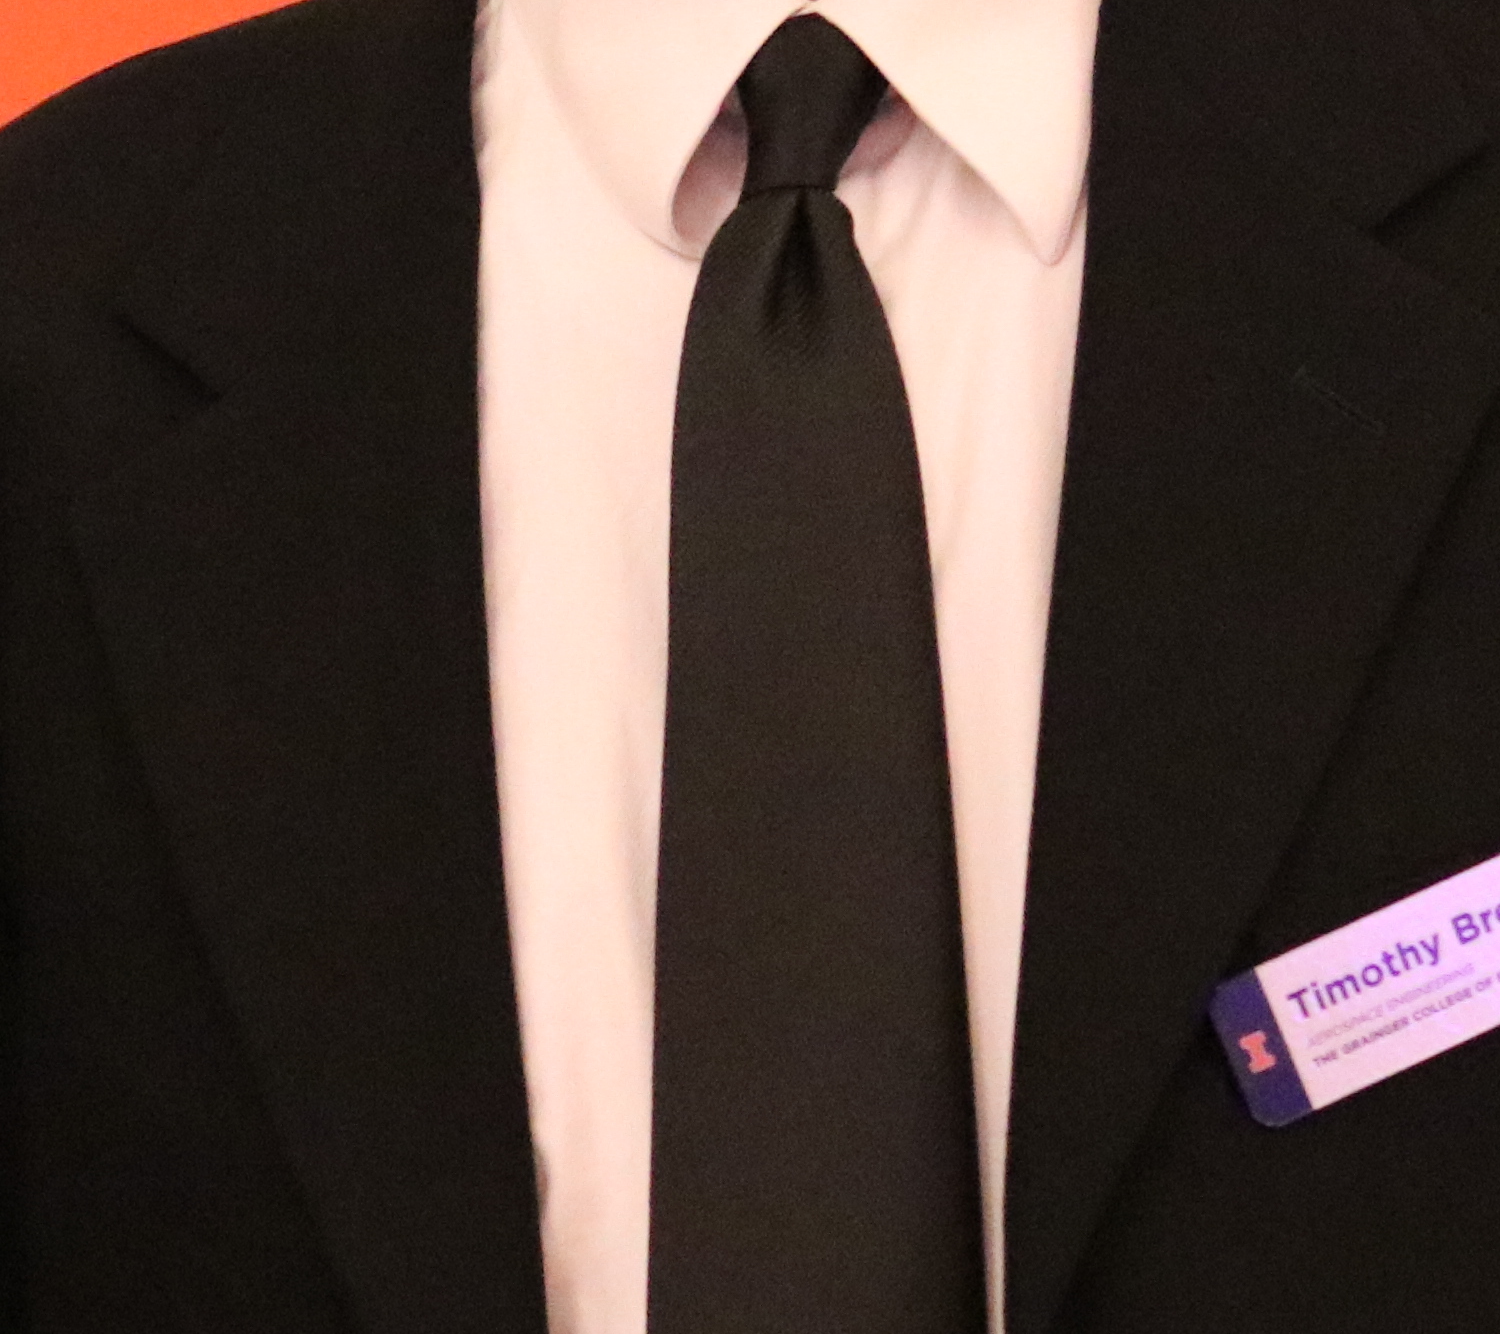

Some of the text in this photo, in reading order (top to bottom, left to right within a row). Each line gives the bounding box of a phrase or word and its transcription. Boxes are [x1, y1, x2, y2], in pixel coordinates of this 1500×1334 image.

[1287, 933, 1440, 1018] Timothy
[1313, 1049, 1339, 1068] THE
[1342, 1016, 1409, 1056] GRAINGER
[1412, 987, 1472, 1022] COLLEGE
[1475, 975, 1493, 993] OF
